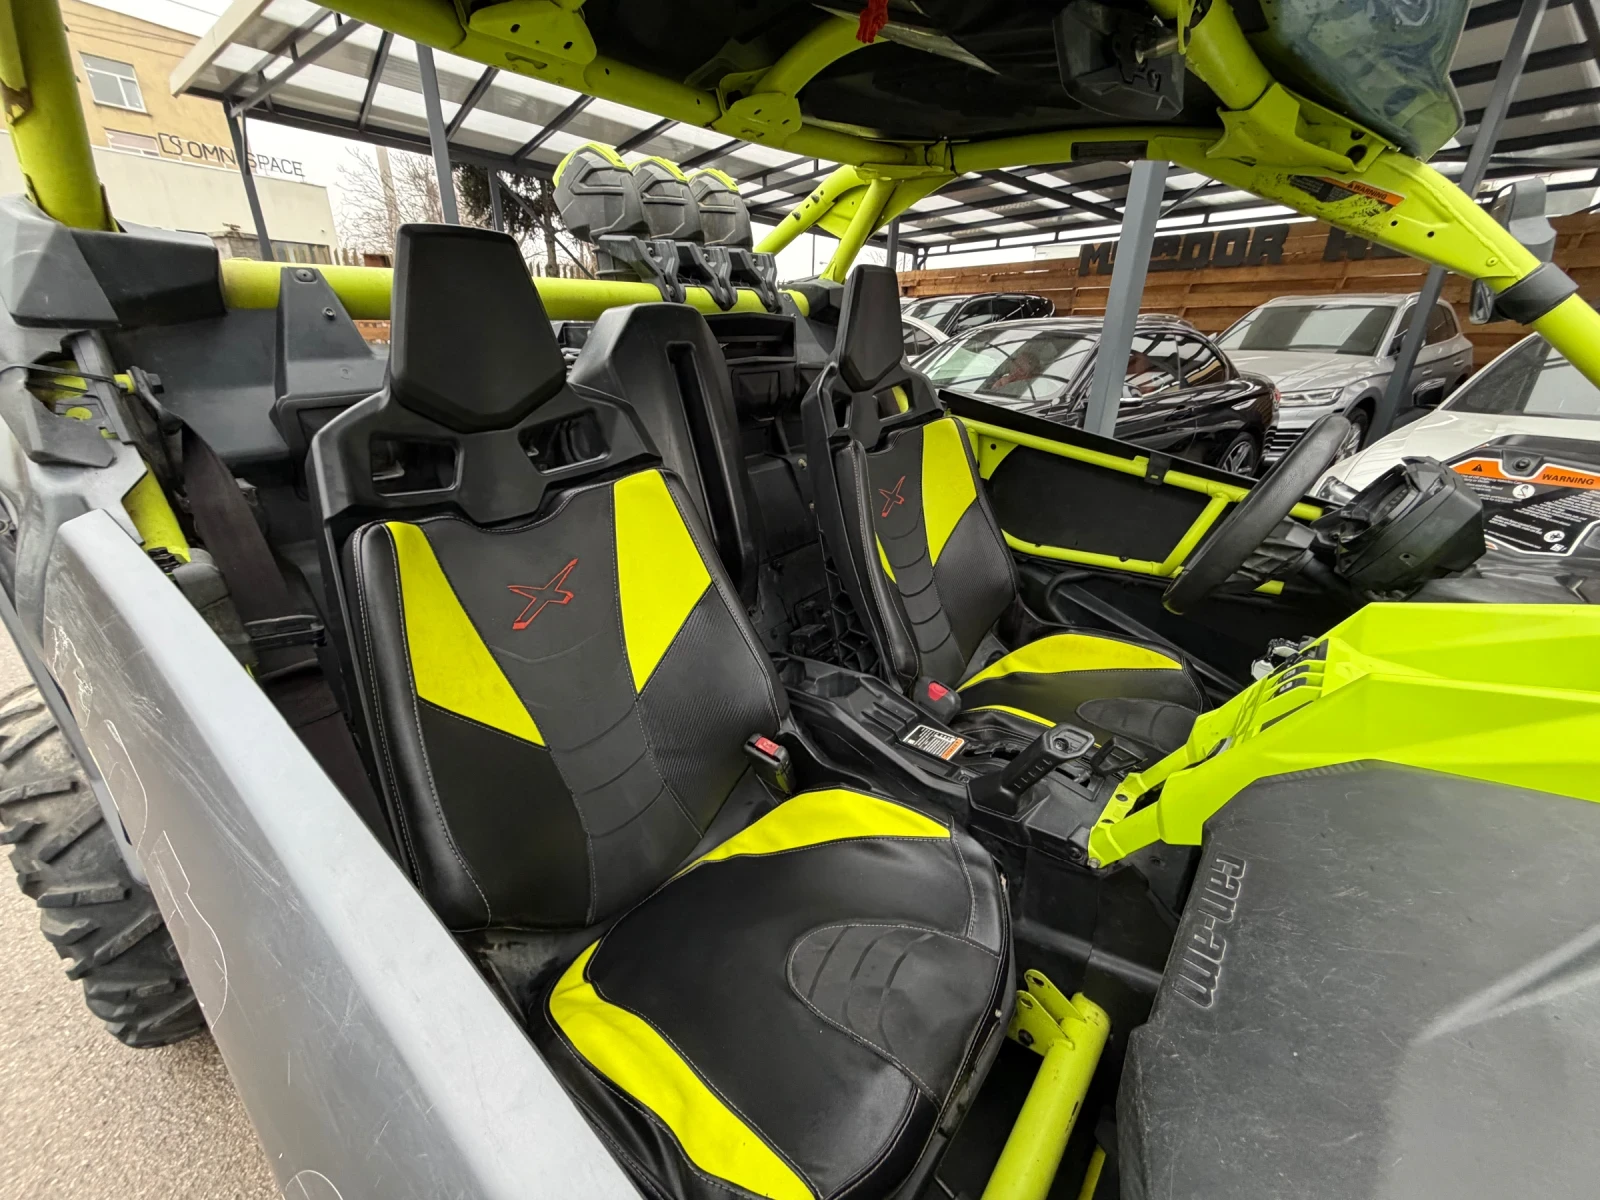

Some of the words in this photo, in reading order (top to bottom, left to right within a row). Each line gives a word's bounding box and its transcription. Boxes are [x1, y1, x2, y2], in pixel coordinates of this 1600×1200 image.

[187, 141, 305, 177] OMNSPACE
[1353, 184, 1388, 200] WARNING
[1541, 473, 1595, 486] WARNING
